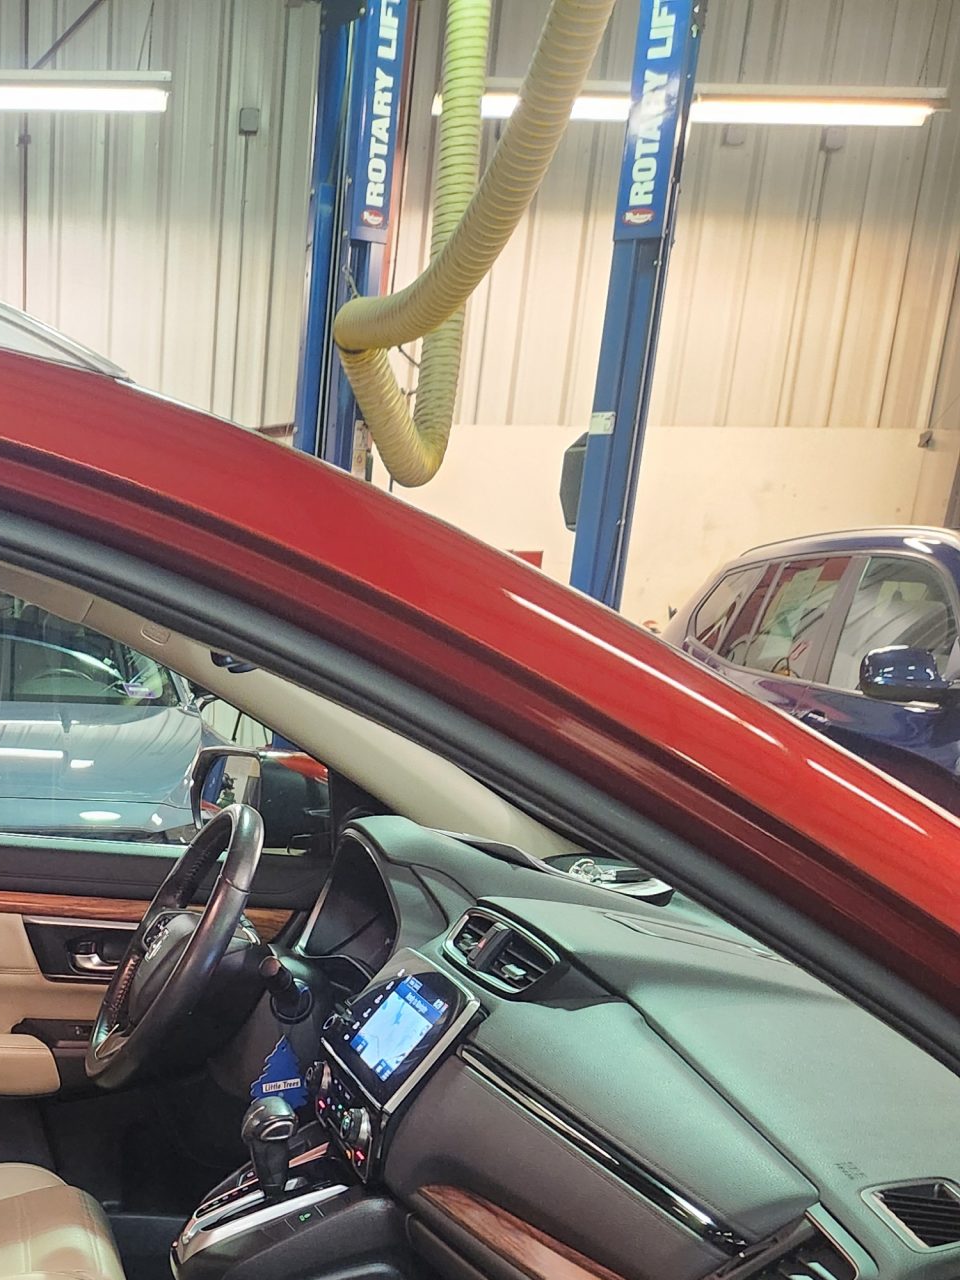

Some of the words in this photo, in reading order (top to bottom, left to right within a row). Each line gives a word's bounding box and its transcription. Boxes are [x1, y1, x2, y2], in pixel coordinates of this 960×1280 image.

[366, 67, 394, 207] ROTARY
[629, 70, 669, 206] ROTARY
[264, 1083, 281, 1092] Little
[283, 1081, 299, 1089] Trees
